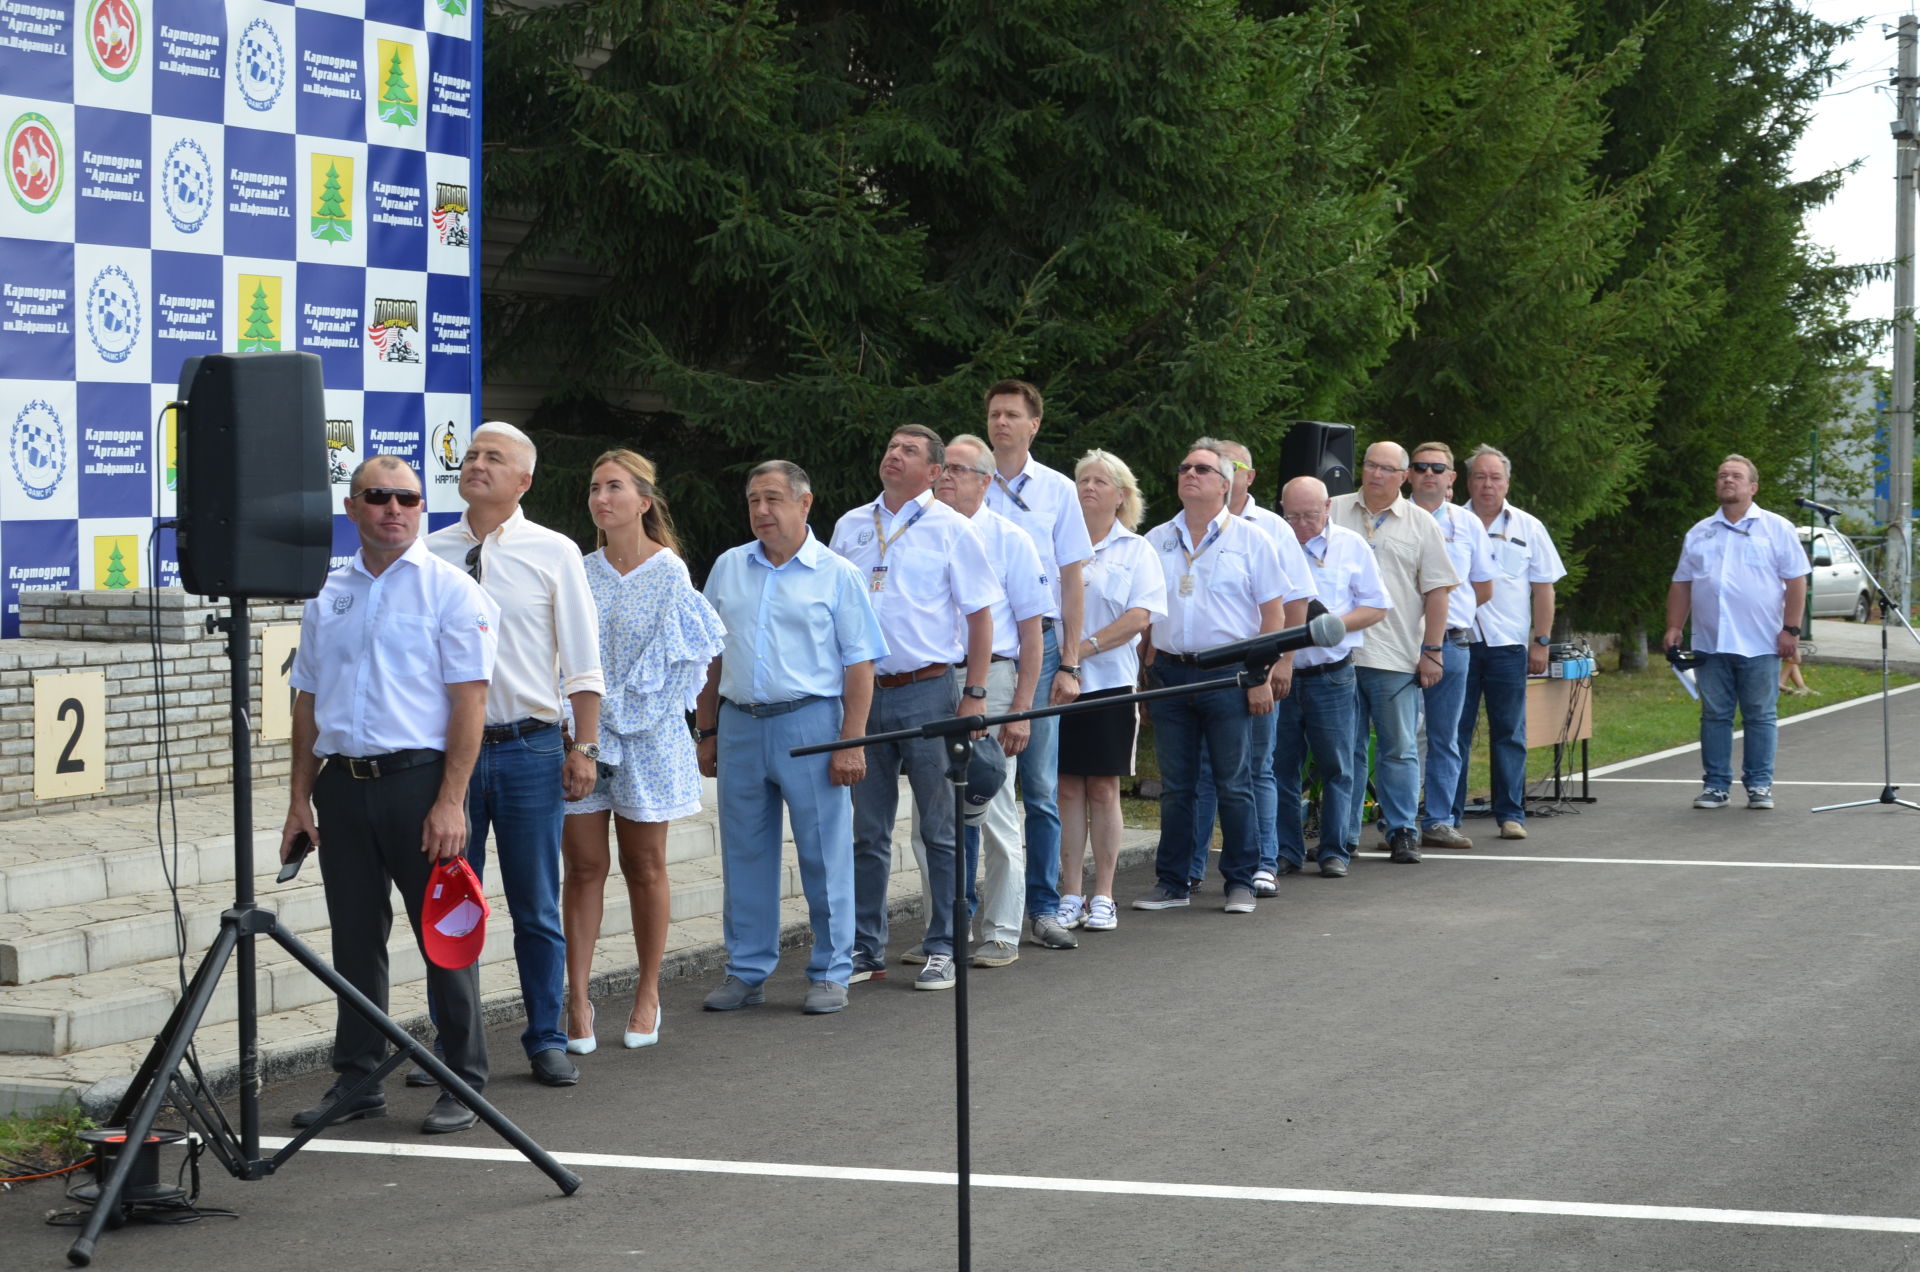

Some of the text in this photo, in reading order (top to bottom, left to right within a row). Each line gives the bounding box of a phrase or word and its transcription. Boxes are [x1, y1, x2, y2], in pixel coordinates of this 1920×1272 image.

[160, 25, 219, 46] Картодром
[304, 50, 357, 69] Картодром
[83, 151, 142, 169] Картодром
[231, 168, 287, 186] Картодром
[373, 181, 420, 198] Картодром
[4, 284, 66, 300] Картодром
[159, 294, 215, 309] Картодром
[304, 304, 358, 319] Картодром
[85, 428, 144, 443] Картодром
[370, 429, 419, 443] Картодром
[9, 566, 70, 581] Картодром
[56, 697, 85, 774] 2
